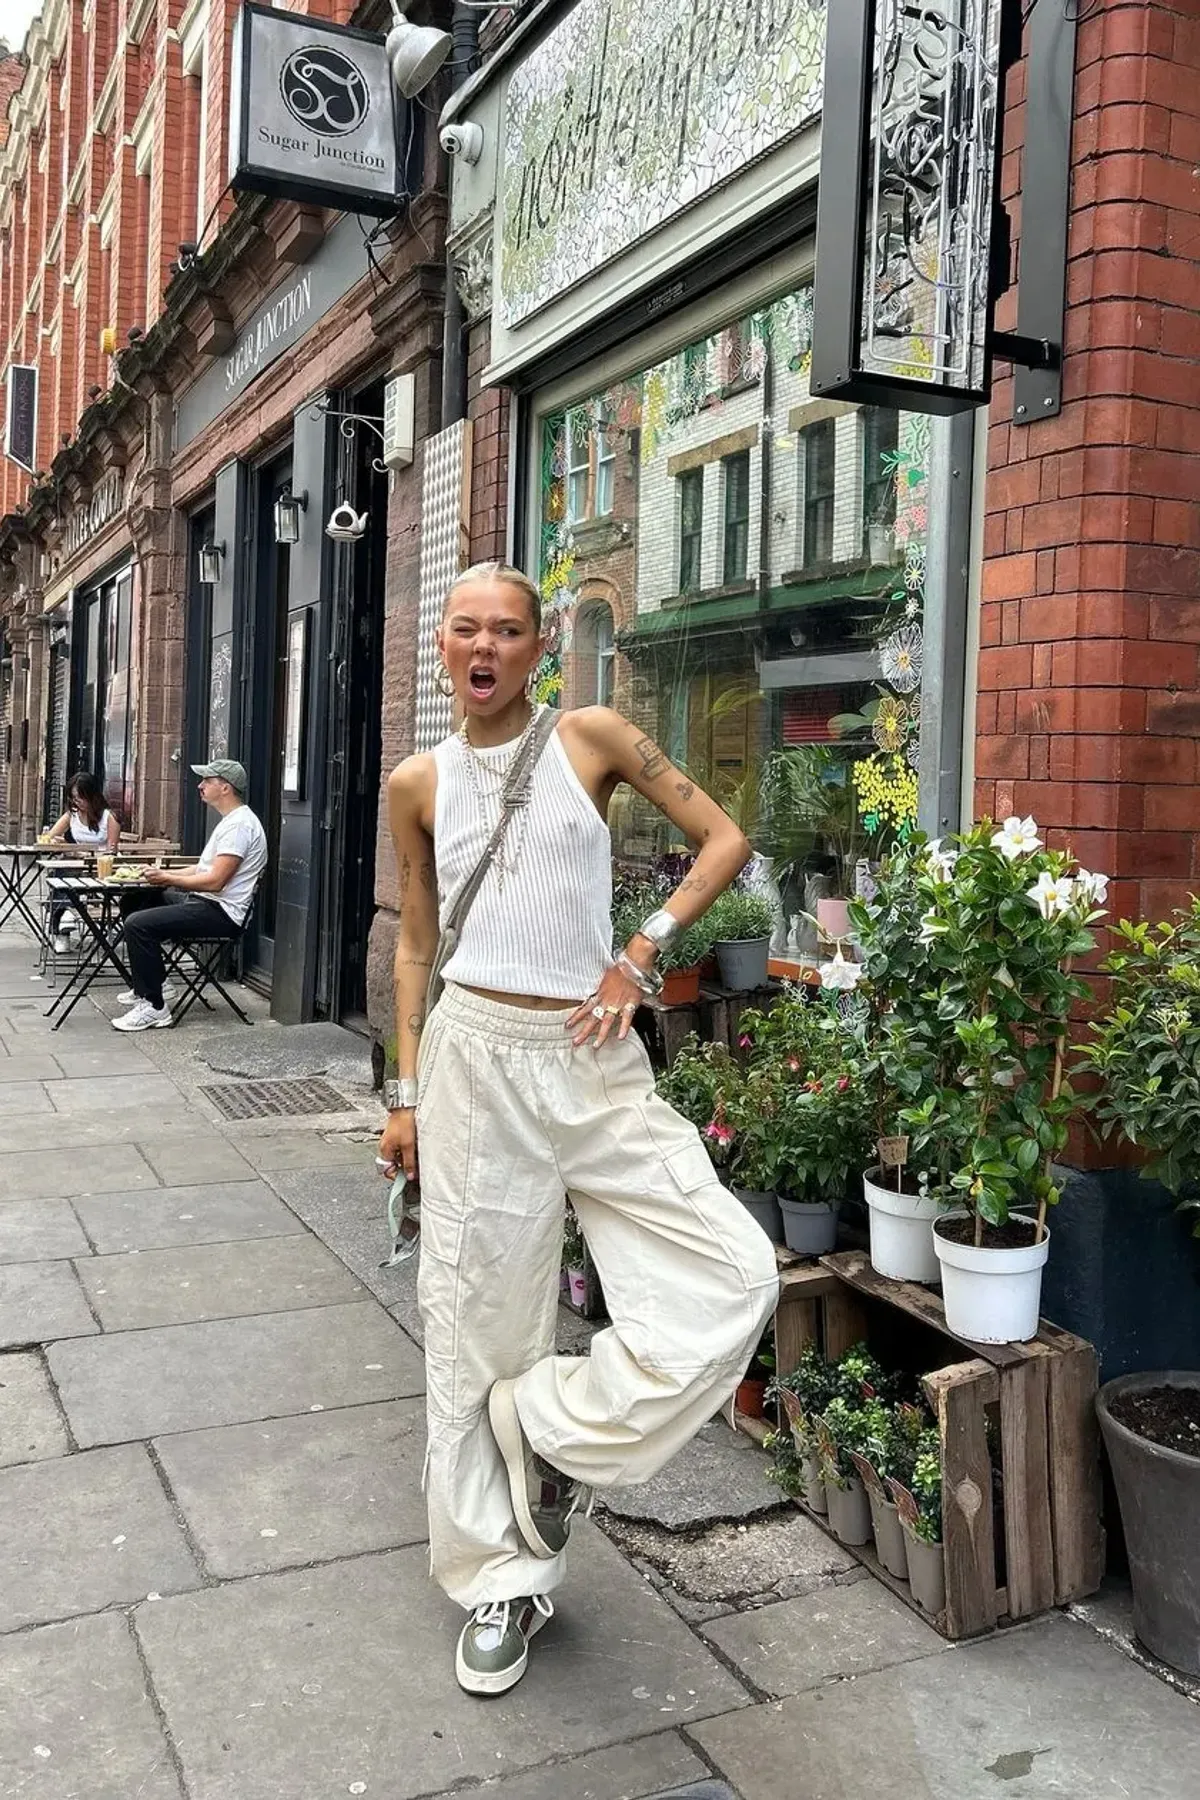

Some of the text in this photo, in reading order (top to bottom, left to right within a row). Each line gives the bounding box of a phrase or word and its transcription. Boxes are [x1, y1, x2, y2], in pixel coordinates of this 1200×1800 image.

[257, 125, 309, 152] Sugar
[314, 139, 386, 169] Junction
[225, 271, 313, 391] SUGAR JUNCTION
